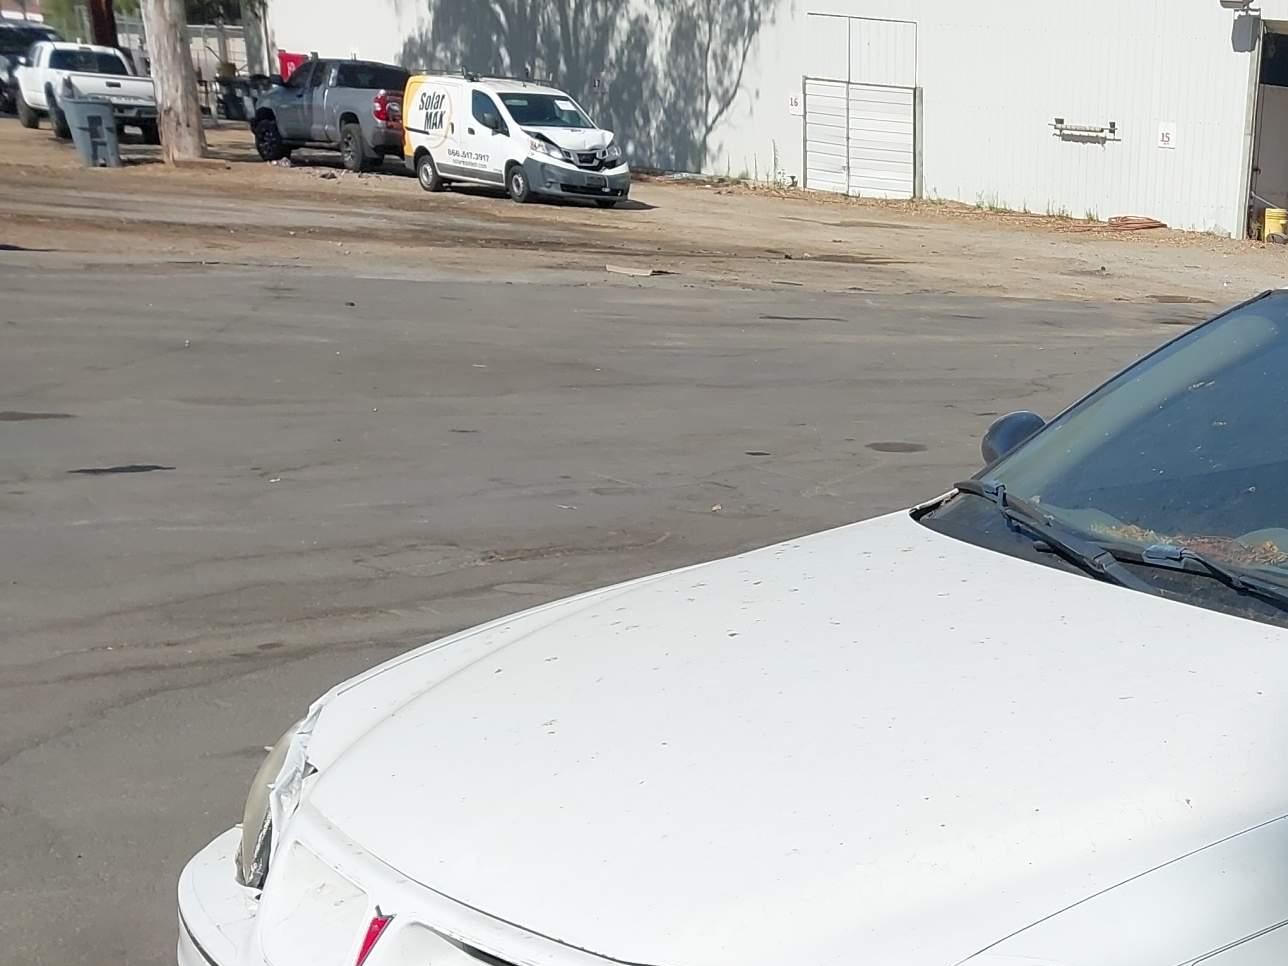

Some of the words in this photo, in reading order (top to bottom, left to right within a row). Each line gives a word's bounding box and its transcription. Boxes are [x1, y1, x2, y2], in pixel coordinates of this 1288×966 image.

[419, 91, 446, 111] Solar
[424, 110, 446, 130] MAX
[1160, 132, 1171, 142] 15
